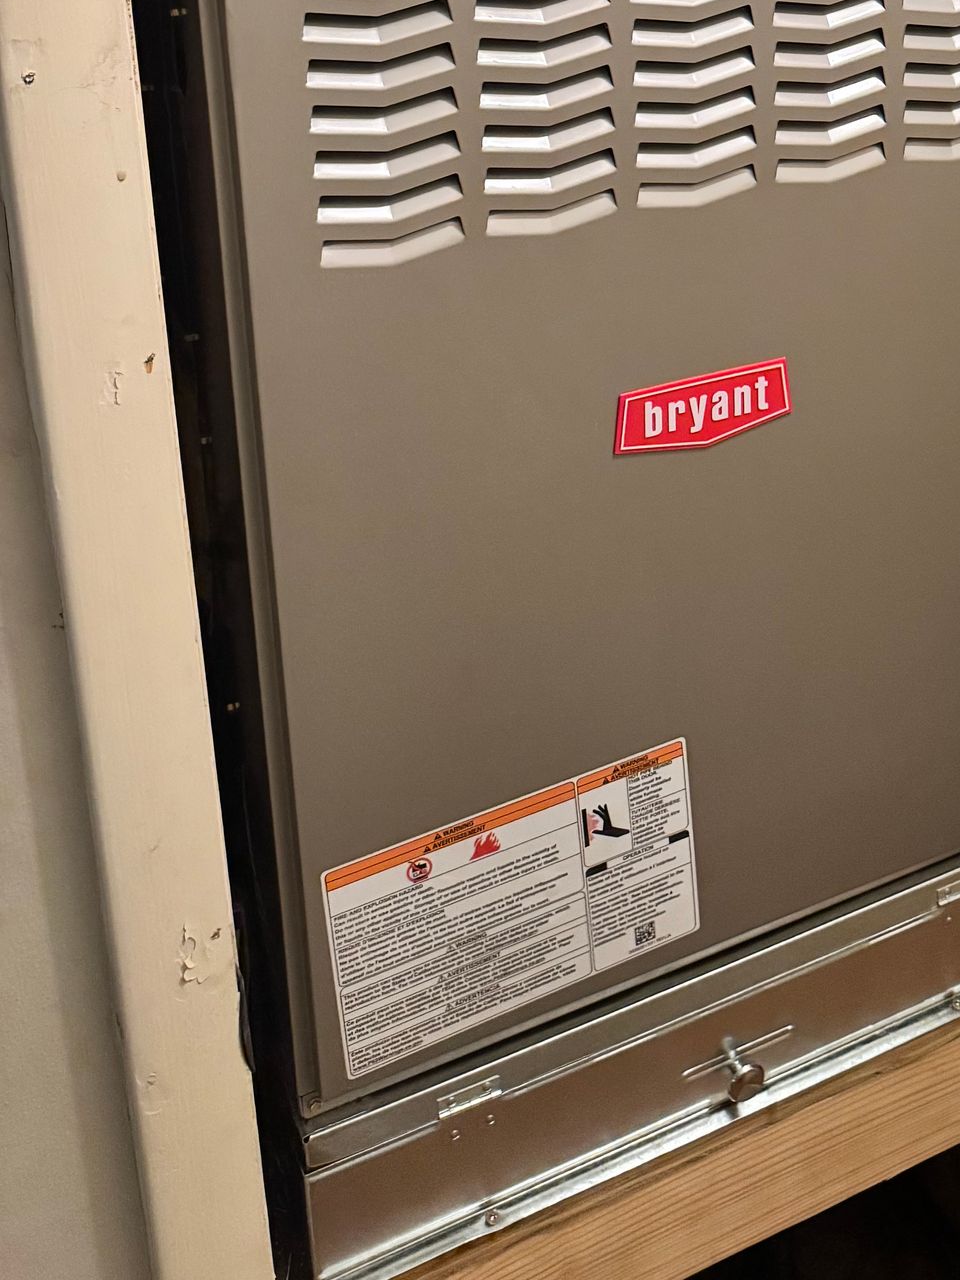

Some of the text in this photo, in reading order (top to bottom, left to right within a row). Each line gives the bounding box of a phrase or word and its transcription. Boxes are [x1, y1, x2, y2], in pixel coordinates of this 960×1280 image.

[644, 375, 769, 439] bryant
[620, 755, 648, 770] WARNING
[443, 820, 474, 836] WARNING
[432, 824, 486, 850] AVERTISSEMENT
[623, 845, 654, 860] OPERATION
[456, 932, 487, 948] WARNING
